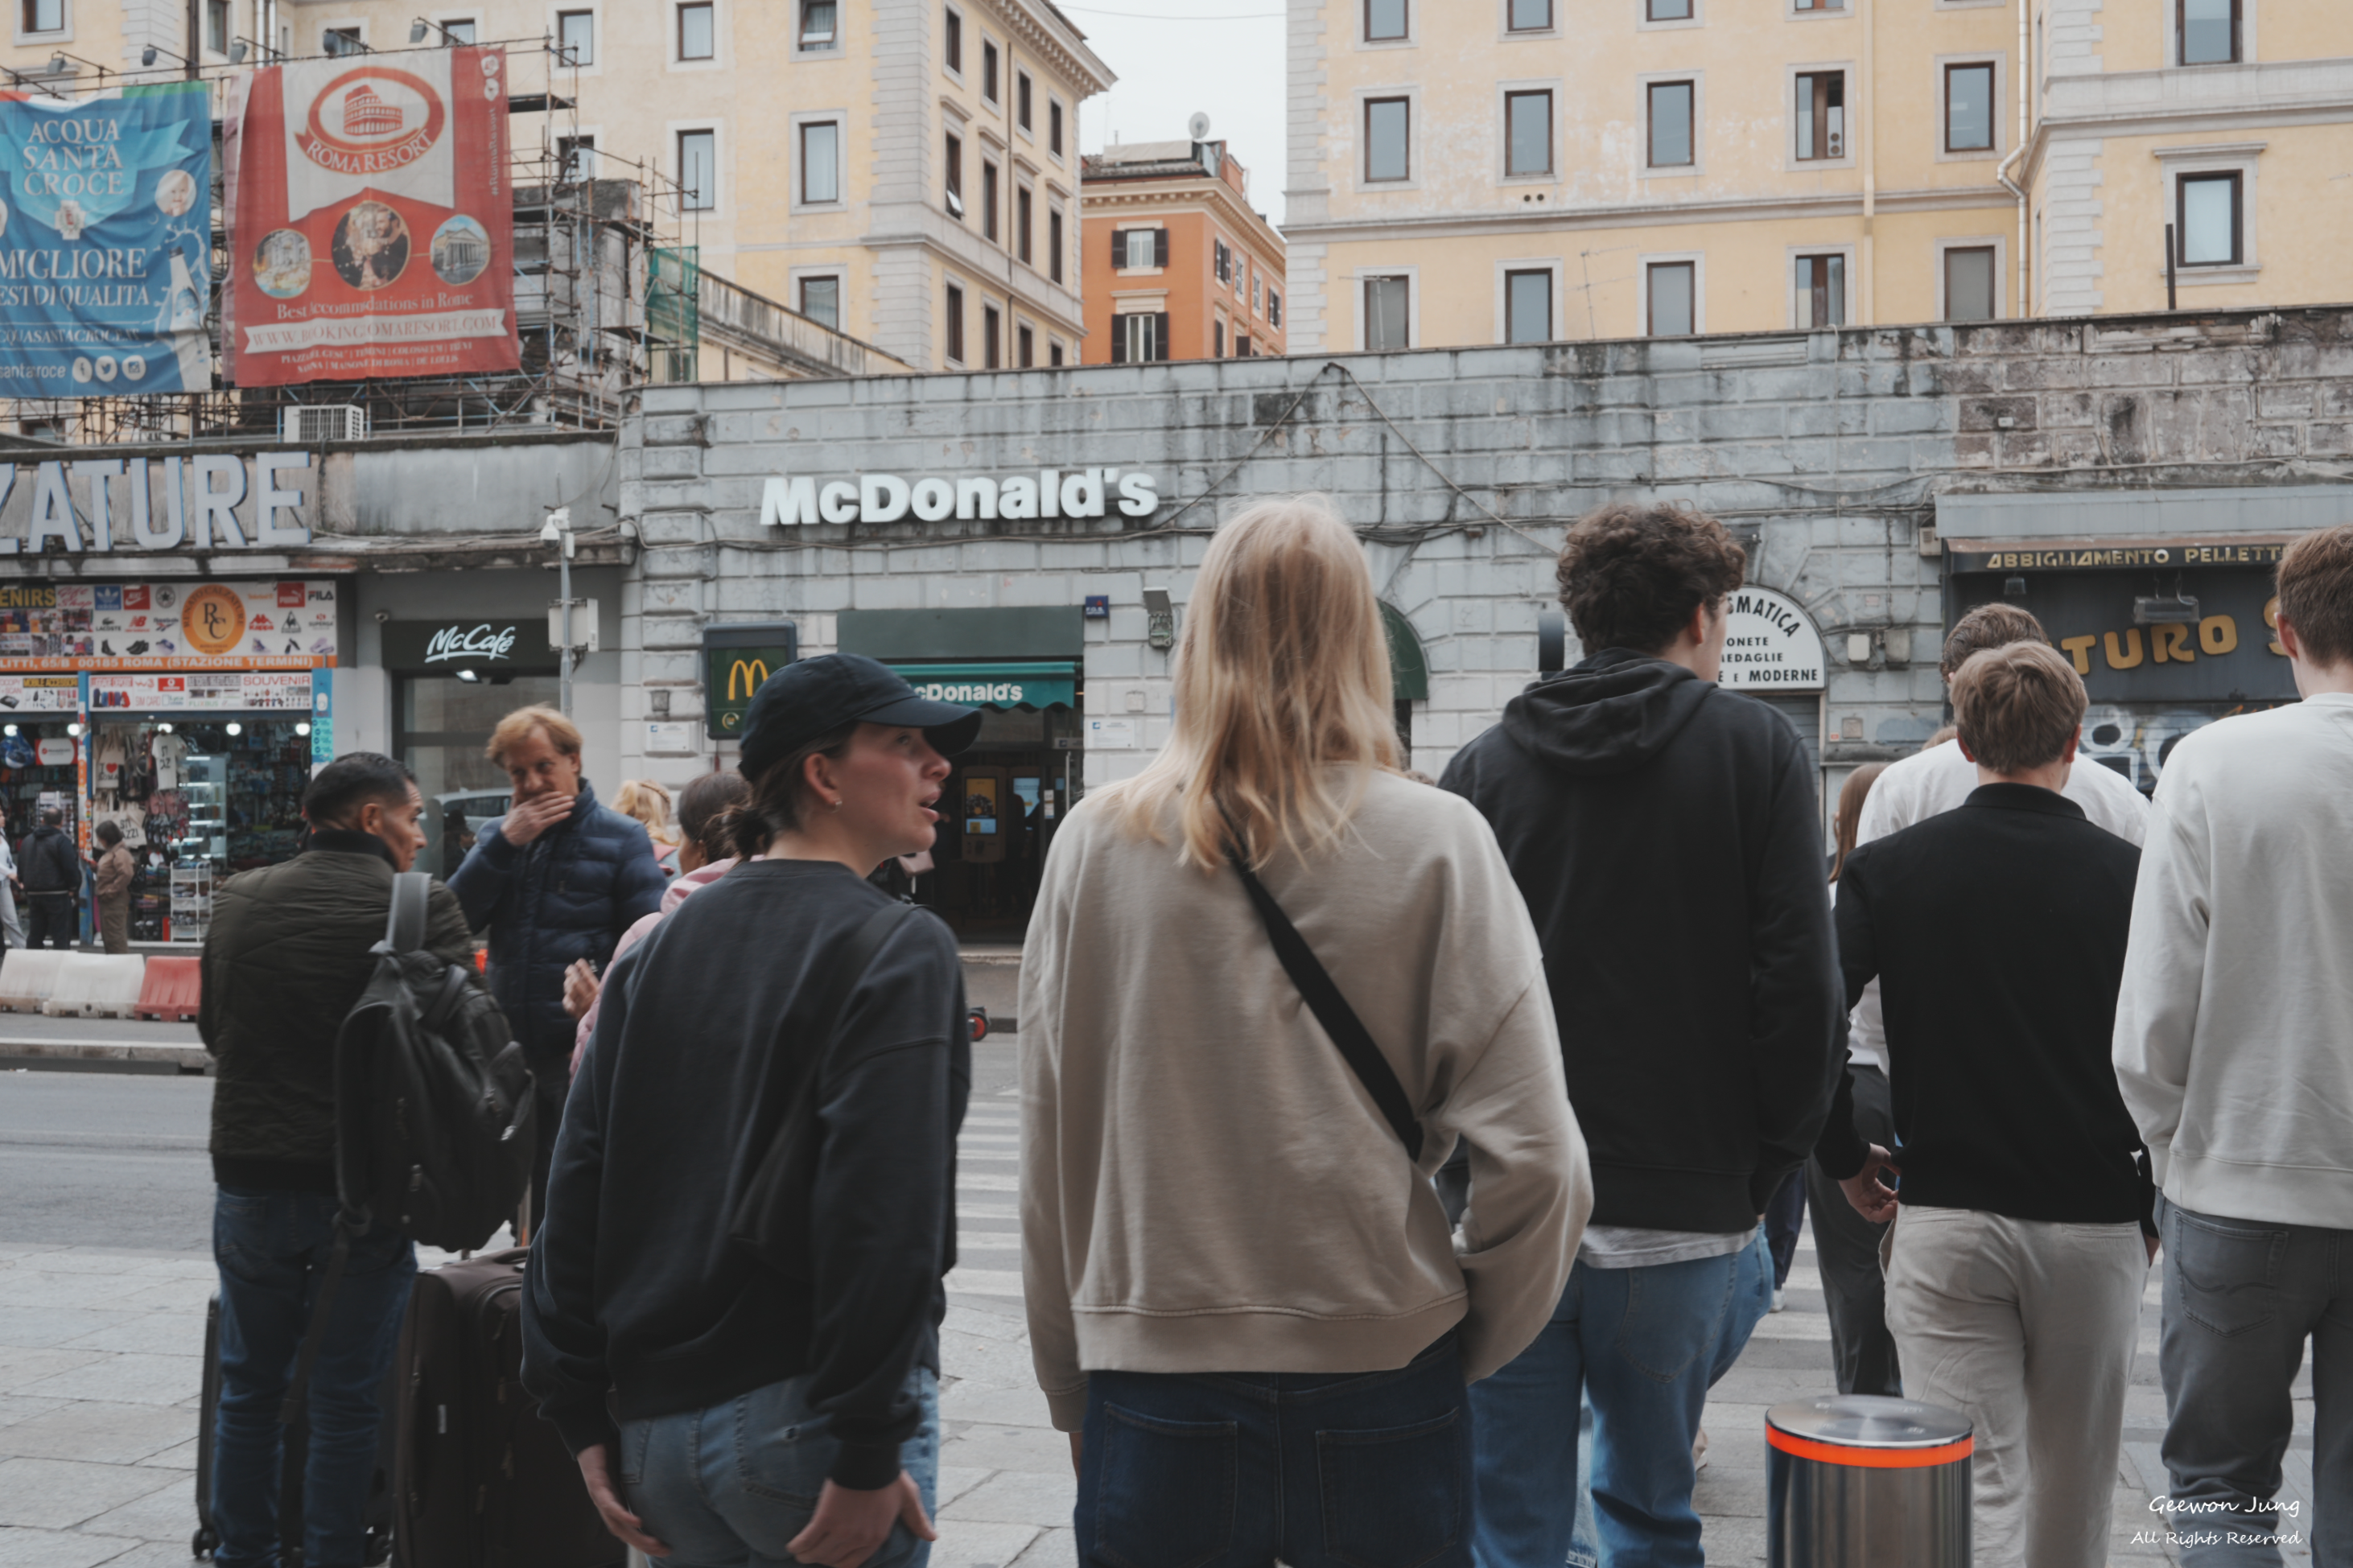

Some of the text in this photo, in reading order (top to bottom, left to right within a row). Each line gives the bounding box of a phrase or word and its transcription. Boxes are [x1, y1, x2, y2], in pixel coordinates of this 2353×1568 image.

[27, 118, 122, 144] ACQUA
[23, 144, 124, 171] SANTA
[23, 171, 124, 195] CROCE
[0, 248, 147, 280] MIGLIORE
[33, 285, 56, 307] DI
[278, 303, 307, 319] Best
[421, 293, 435, 309] in
[438, 292, 473, 308] Rome
[760, 467, 1159, 525] McDonald's
[1986, 548, 2170, 568] ABBIGLIAMENTO
[0, 588, 56, 607] ENIRS
[308, 590, 334, 601] FILA
[426, 623, 516, 661] McCafé
[1725, 636, 1769, 647] ONETE
[2052, 614, 2238, 676] TURO
[0, 656, 313, 669] LITTI, 65/B 00185 ROMA (STAZIONE TERMINI)
[244, 676, 311, 686] SOUVENIR
[1749, 669, 1818, 681] MODERNE
[913, 683, 1023, 702] cDonald's
